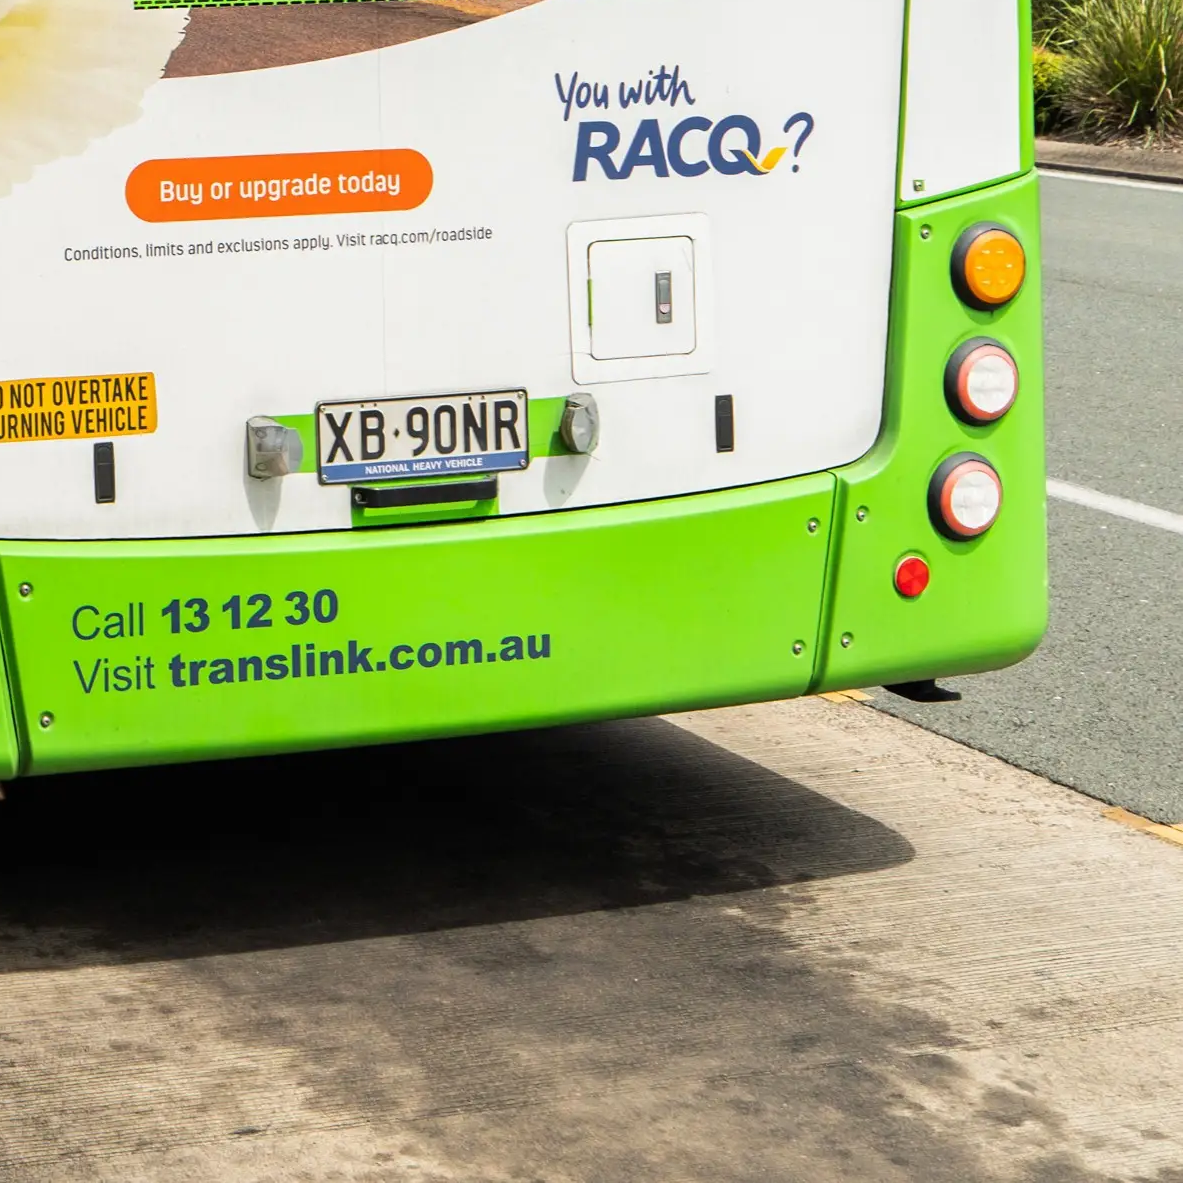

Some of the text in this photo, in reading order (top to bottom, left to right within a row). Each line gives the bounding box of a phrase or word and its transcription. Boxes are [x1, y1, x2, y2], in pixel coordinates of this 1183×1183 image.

[555, 65, 696, 122] You with
[160, 170, 401, 205] Buy or upgrade today
[64, 226, 493, 262] Conditions, limits and exclusions apply. Visit racq.com/roadside
[10, 382, 46, 409] NOT
[52, 375, 148, 406] OVERTAKE
[71, 406, 148, 434] VEHICLE
[365, 457, 483, 475] NATIONAL HEAVY VEHICLE
[72, 589, 339, 641] Call 13 12 30
[73, 633, 551, 695] Visit translink.com.au
